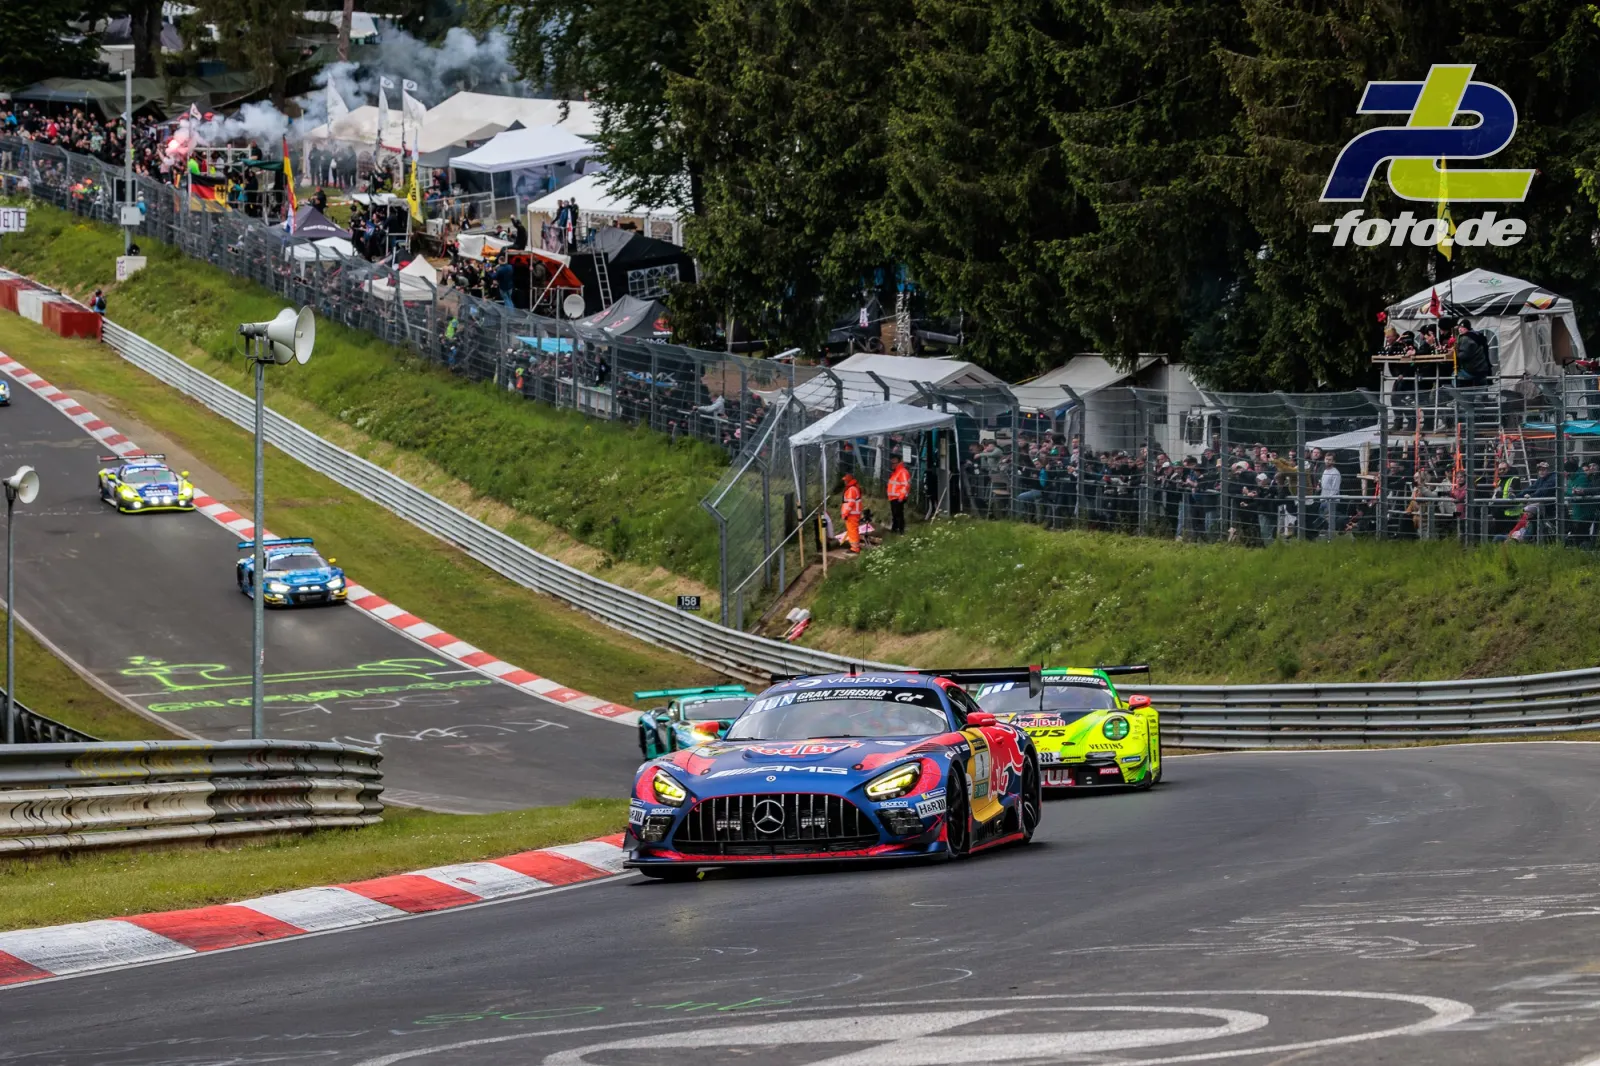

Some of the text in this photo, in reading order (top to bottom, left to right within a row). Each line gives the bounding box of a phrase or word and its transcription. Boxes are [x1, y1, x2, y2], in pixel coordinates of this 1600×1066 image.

[0, 210, 26, 229] ETE
[681, 596, 697, 606] 158
[827, 676, 901, 685] viaplay
[797, 689, 832, 700] GRAN
[1039, 718, 1066, 727] Bull
[743, 743, 800, 756] Red
[1089, 742, 1124, 750] VELTINS
[760, 765, 848, 775] AMG
[880, 800, 908, 808] sparco
[919, 802, 938, 815] H&R
